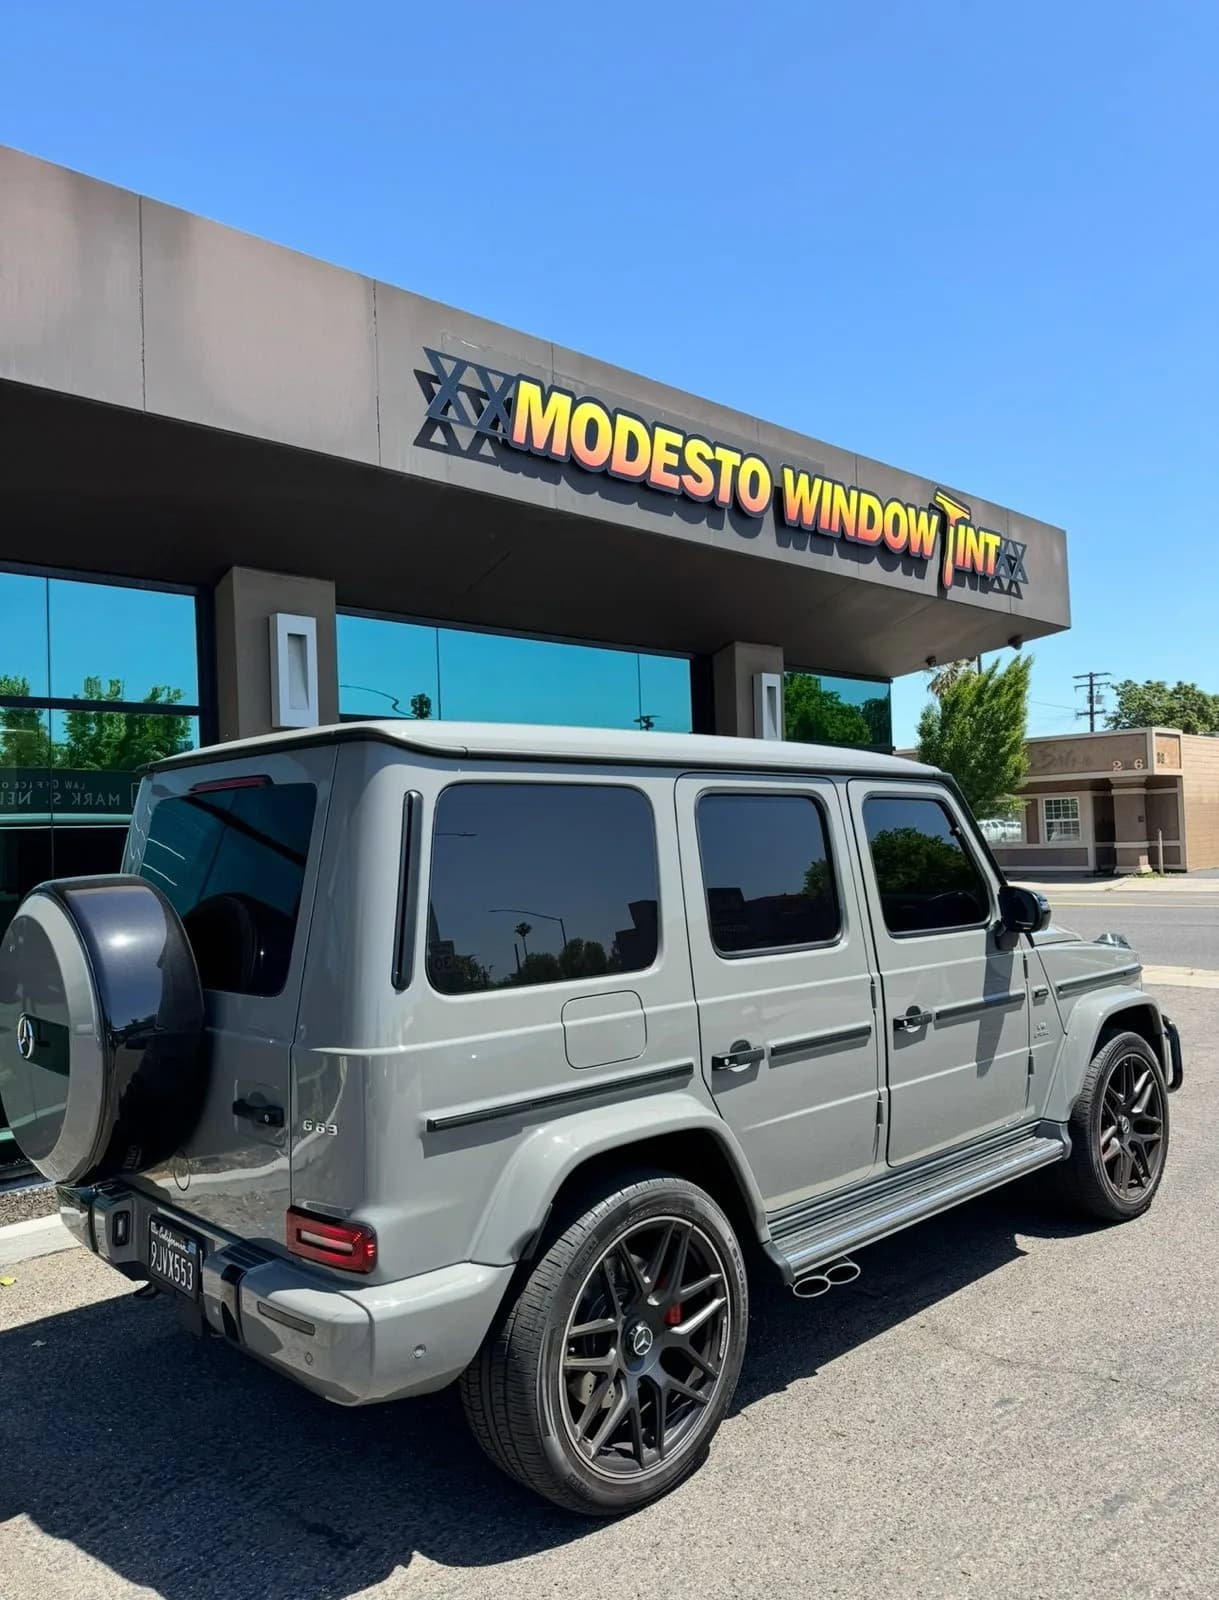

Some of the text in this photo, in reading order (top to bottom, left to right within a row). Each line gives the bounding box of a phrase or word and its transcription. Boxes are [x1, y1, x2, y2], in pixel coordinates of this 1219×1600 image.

[510, 377, 1002, 589] MODESTO WINDOW TINT
[150, 1240, 193, 1291] 9JVX553
